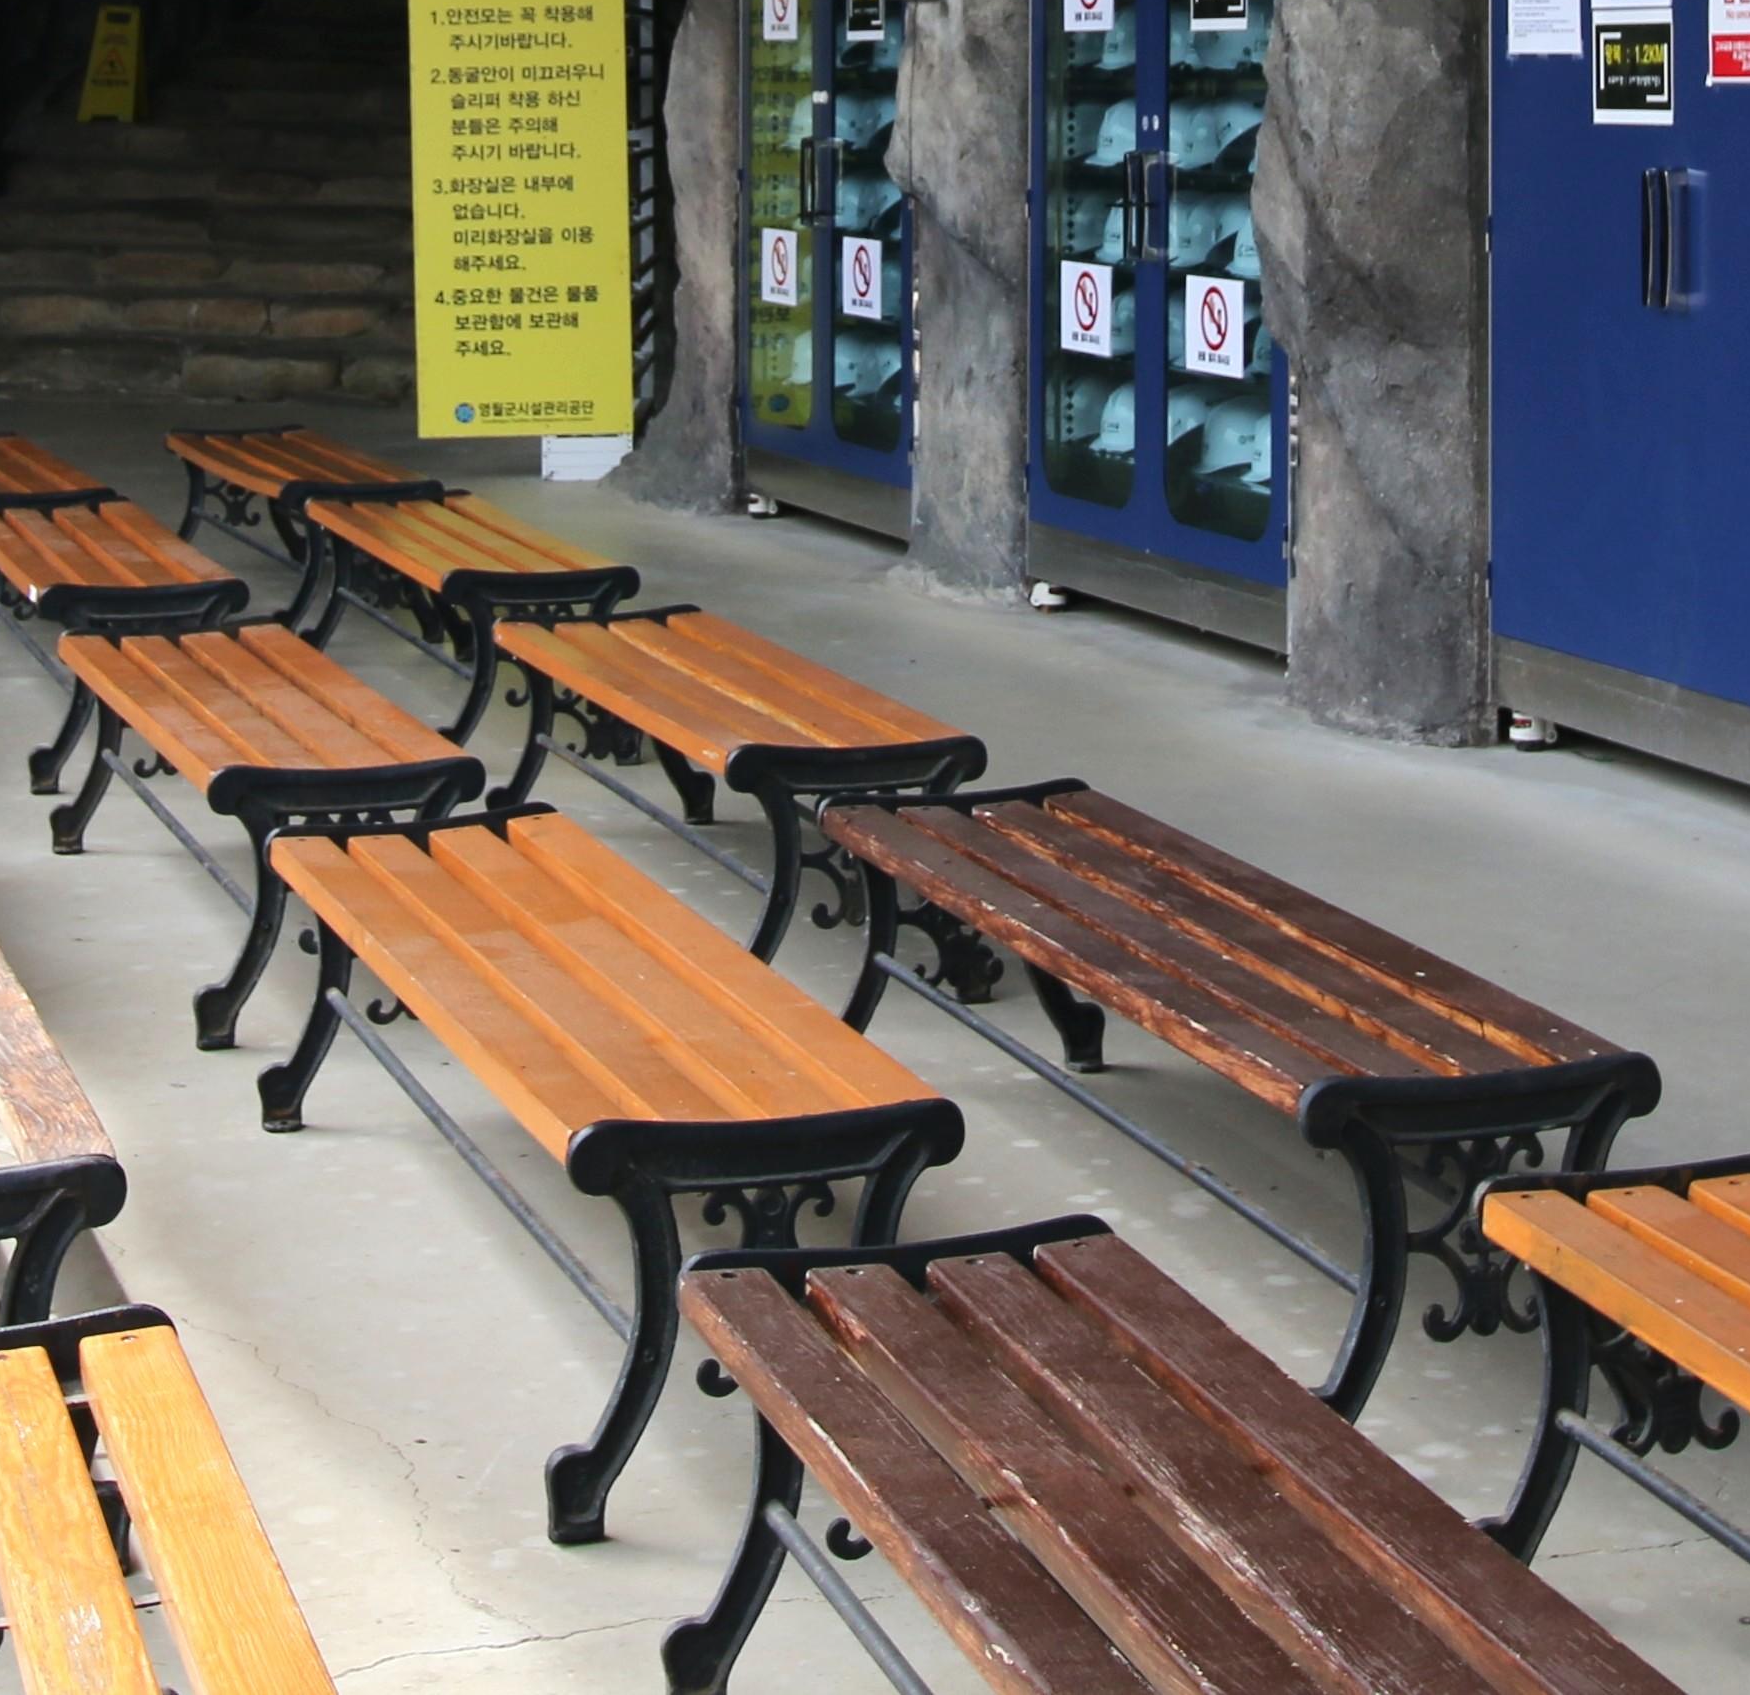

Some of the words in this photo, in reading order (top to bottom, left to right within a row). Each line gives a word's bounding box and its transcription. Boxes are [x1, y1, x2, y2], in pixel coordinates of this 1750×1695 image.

[521, 7, 536, 23] 꼭
[544, 5, 594, 23] 착용해
[521, 63, 604, 82] 미끄러우니
[451, 92, 501, 110] 슬리퍼
[508, 91, 540, 108] 착용
[548, 90, 581, 107] 하신
[452, 118, 501, 136] 분들은
[508, 116, 559, 133] 주의해
[452, 144, 502, 161] 주시기
[508, 142, 582, 160] 바랍니다.
[524, 175, 574, 192] 내부에
[453, 203, 526, 221] 없습니다.
[561, 226, 594, 244] 이용
[453, 254, 527, 272] 해주세요.
[509, 286, 559, 304] 물건은
[566, 285, 599, 303] 물품
[455, 314, 522, 331] 보관함에
[528, 312, 579, 329] 보관해
[455, 339, 511, 357] 주세요.
[479, 400, 594, 418] 영월군시설관리공단
